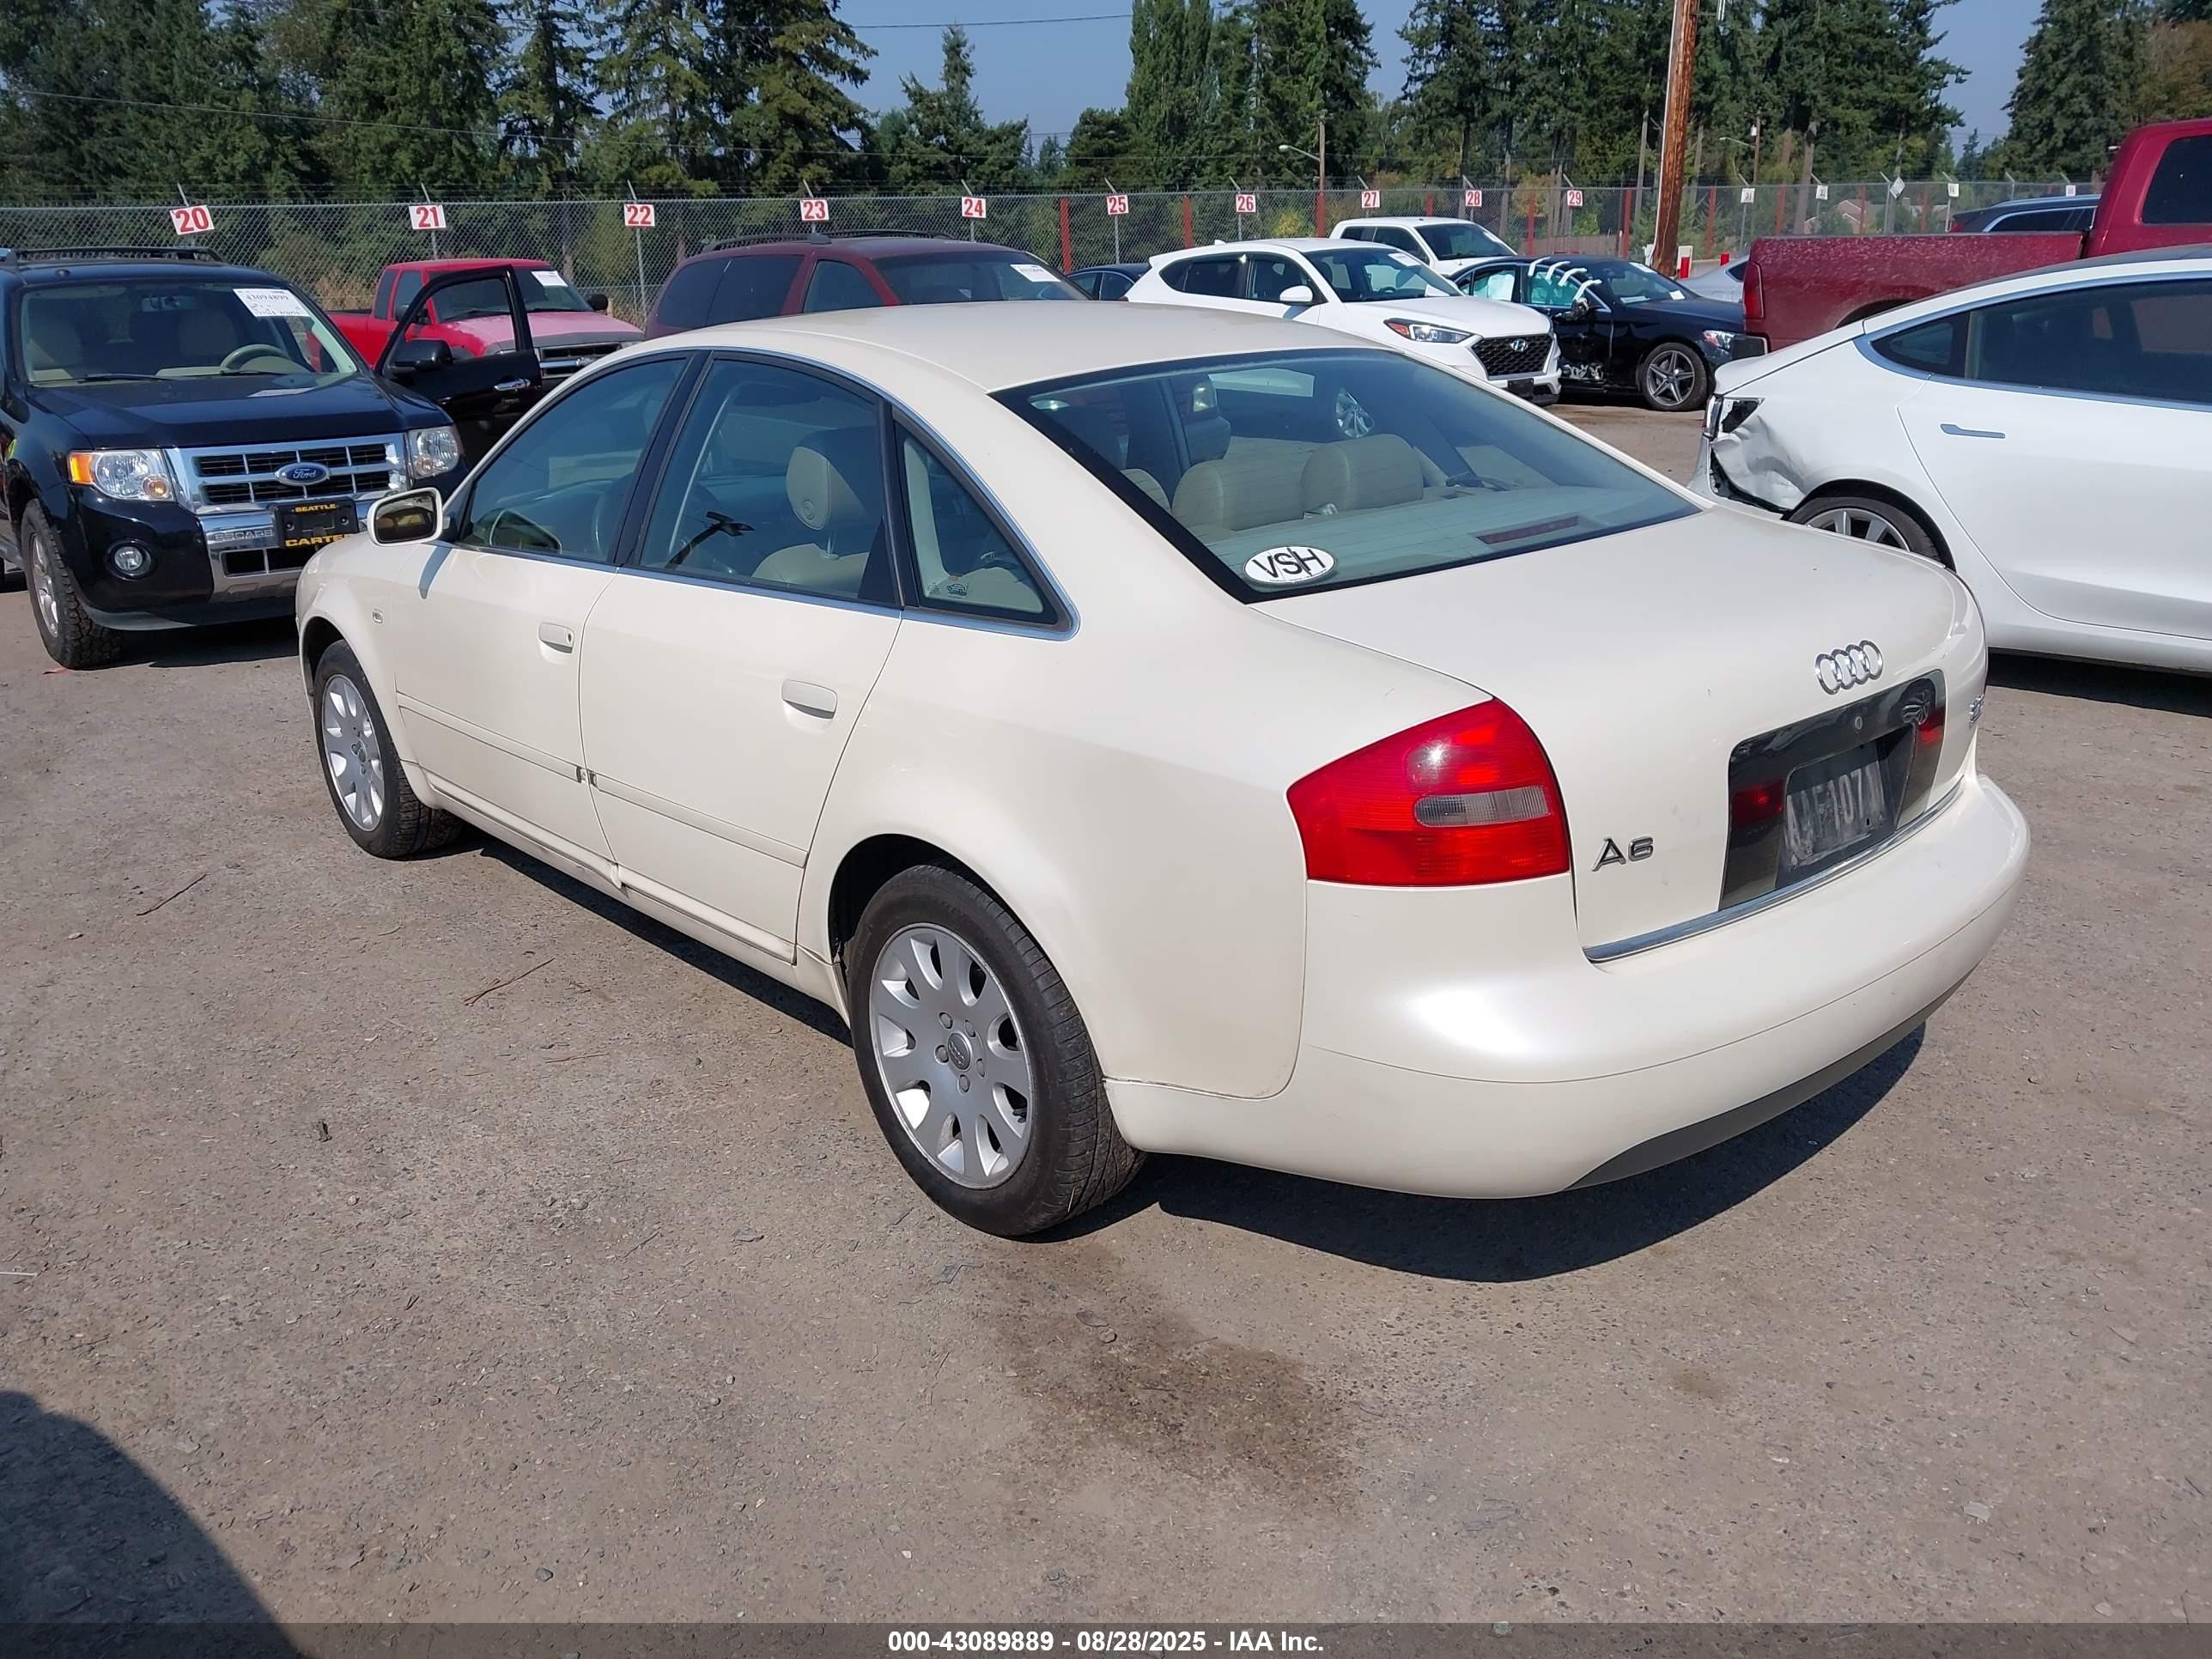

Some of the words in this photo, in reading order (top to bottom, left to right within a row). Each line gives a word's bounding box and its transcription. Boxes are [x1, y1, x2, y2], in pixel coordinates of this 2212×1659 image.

[1109, 197, 1127, 213] 25
[1237, 196, 1254, 210] 26
[1364, 191, 1376, 207] 27
[1468, 191, 1480, 206] 28
[1569, 191, 1582, 205] 29
[627, 205, 651, 225] 22
[803, 201, 825, 219] 23
[964, 198, 983, 216] 24
[175, 207, 209, 233] 20
[416, 206, 440, 228] 21
[292, 468, 317, 479] Ford
[295, 503, 337, 514] SEATTLE
[214, 529, 273, 542] ESCAPE
[285, 534, 344, 548] CARTE
[1251, 548, 1326, 578] VSH
[1592, 837, 1654, 872] A6
